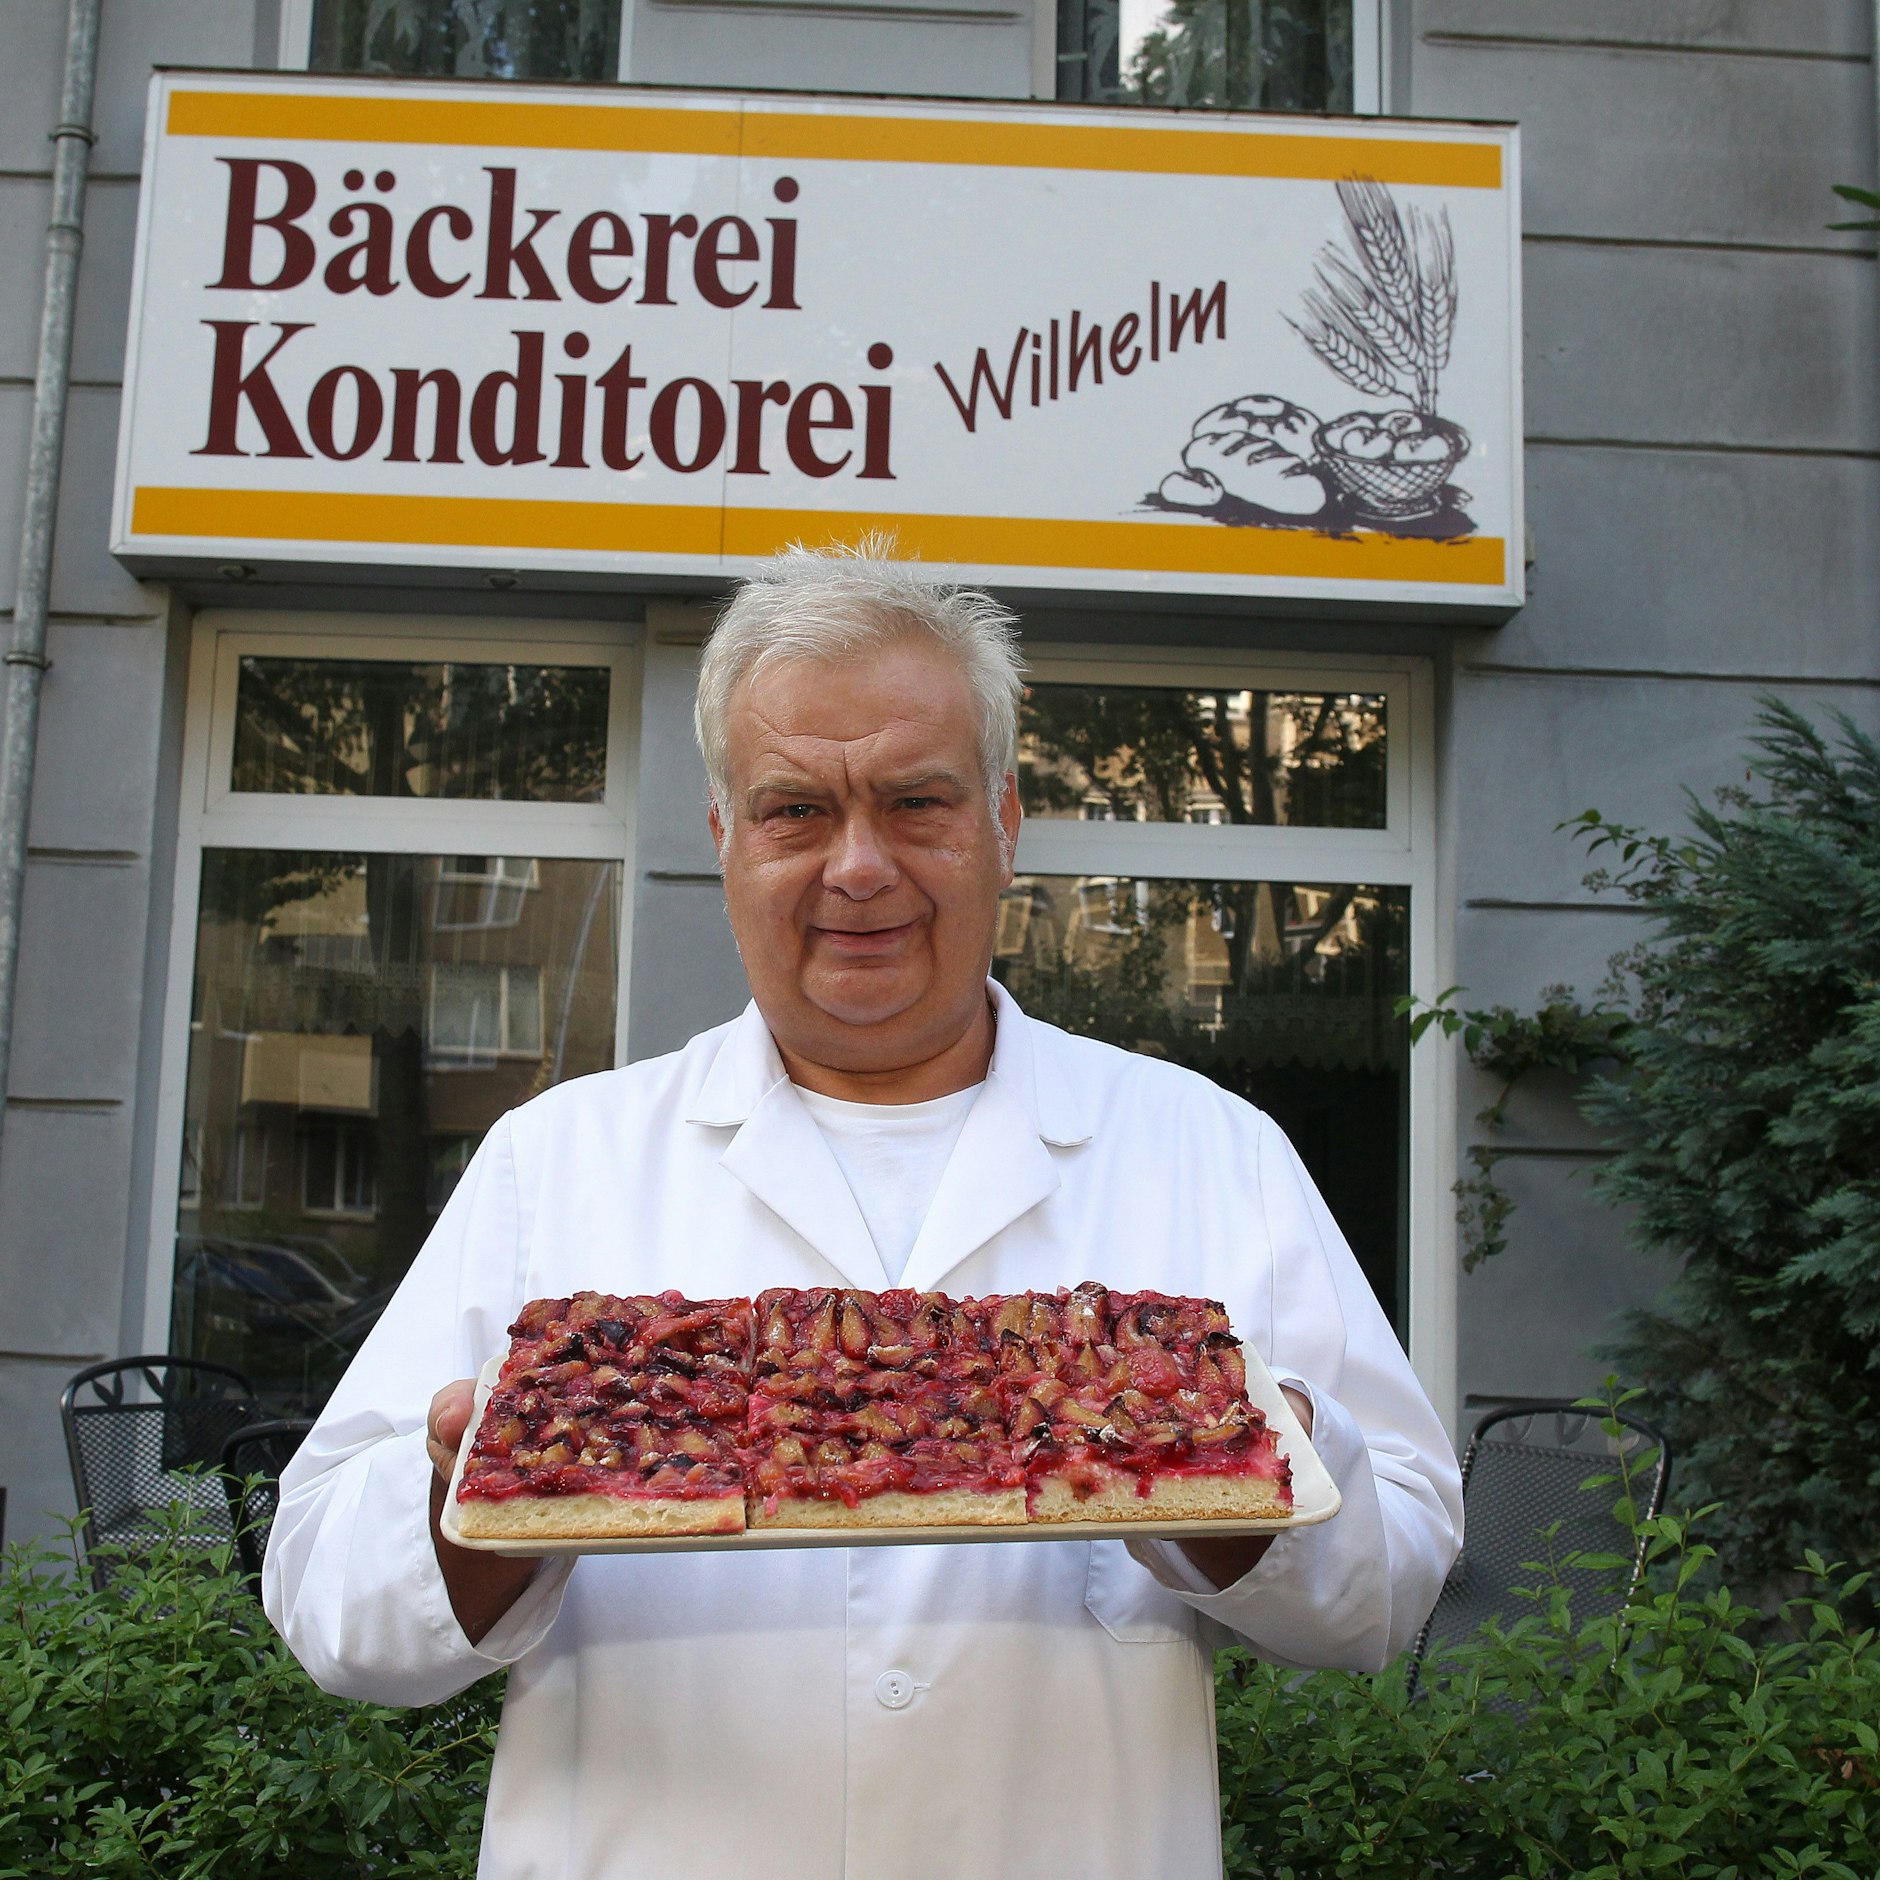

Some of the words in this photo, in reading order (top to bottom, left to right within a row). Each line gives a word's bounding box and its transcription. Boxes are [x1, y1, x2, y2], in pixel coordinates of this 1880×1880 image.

[204, 157, 803, 310] Bäckerei
[189, 319, 898, 481] Konditorei
[934, 280, 1228, 433] Wilhelm
